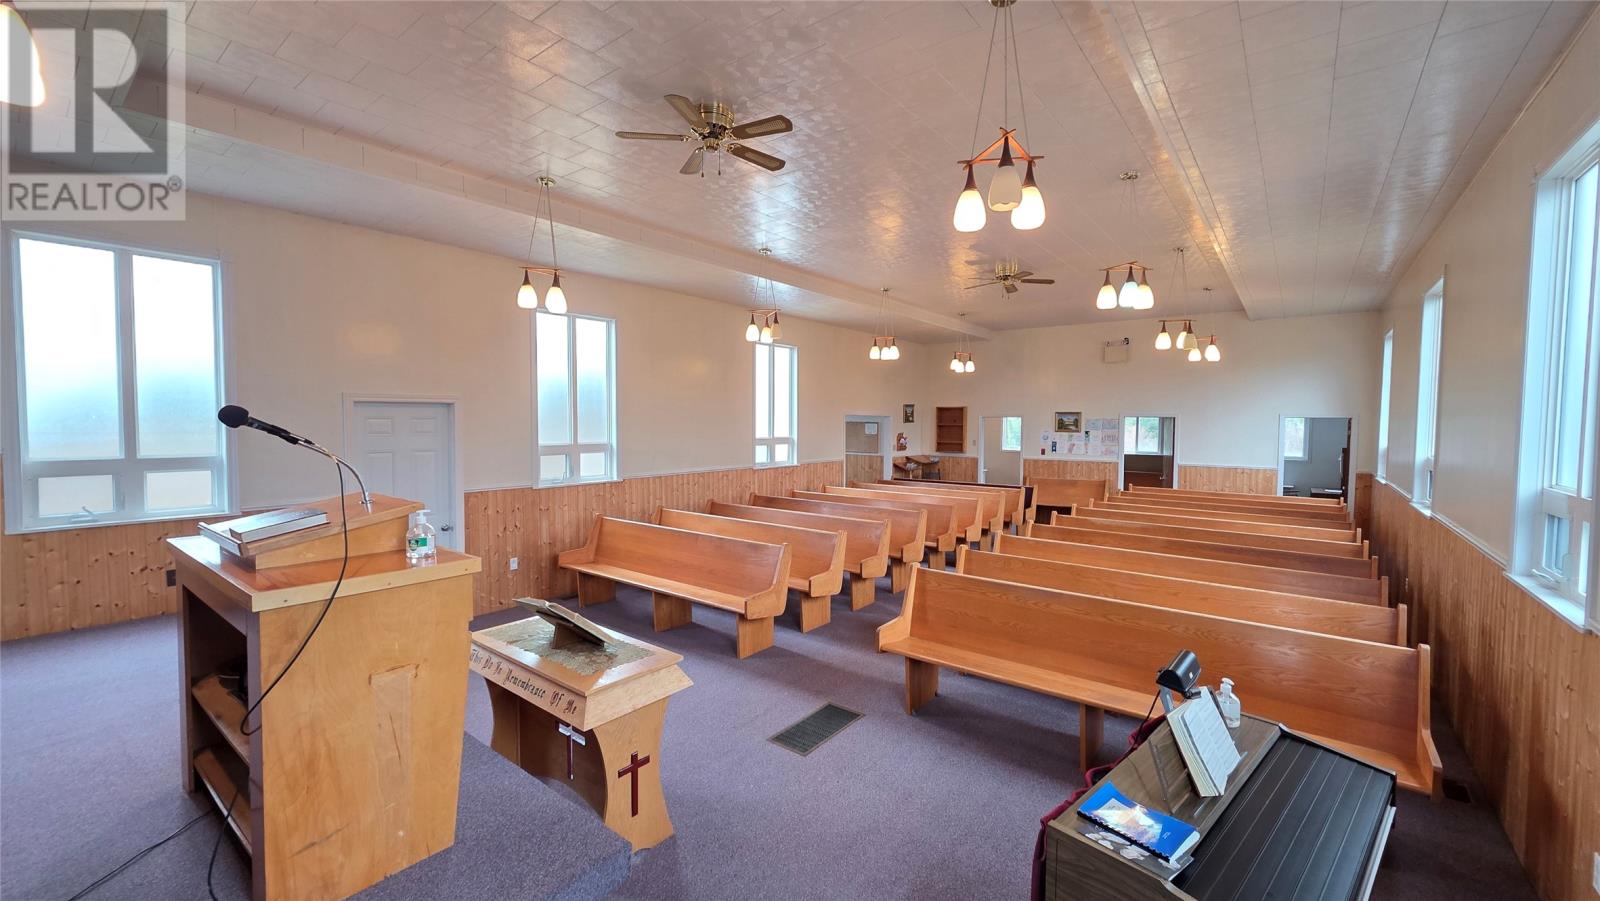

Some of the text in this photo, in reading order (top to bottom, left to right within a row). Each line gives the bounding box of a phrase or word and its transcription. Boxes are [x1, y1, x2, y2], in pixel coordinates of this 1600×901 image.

[481, 655, 494, 669] Do
[503, 666, 546, 698] Remembrance
[549, 690, 564, 708] Of
[563, 699, 577, 715] Me
